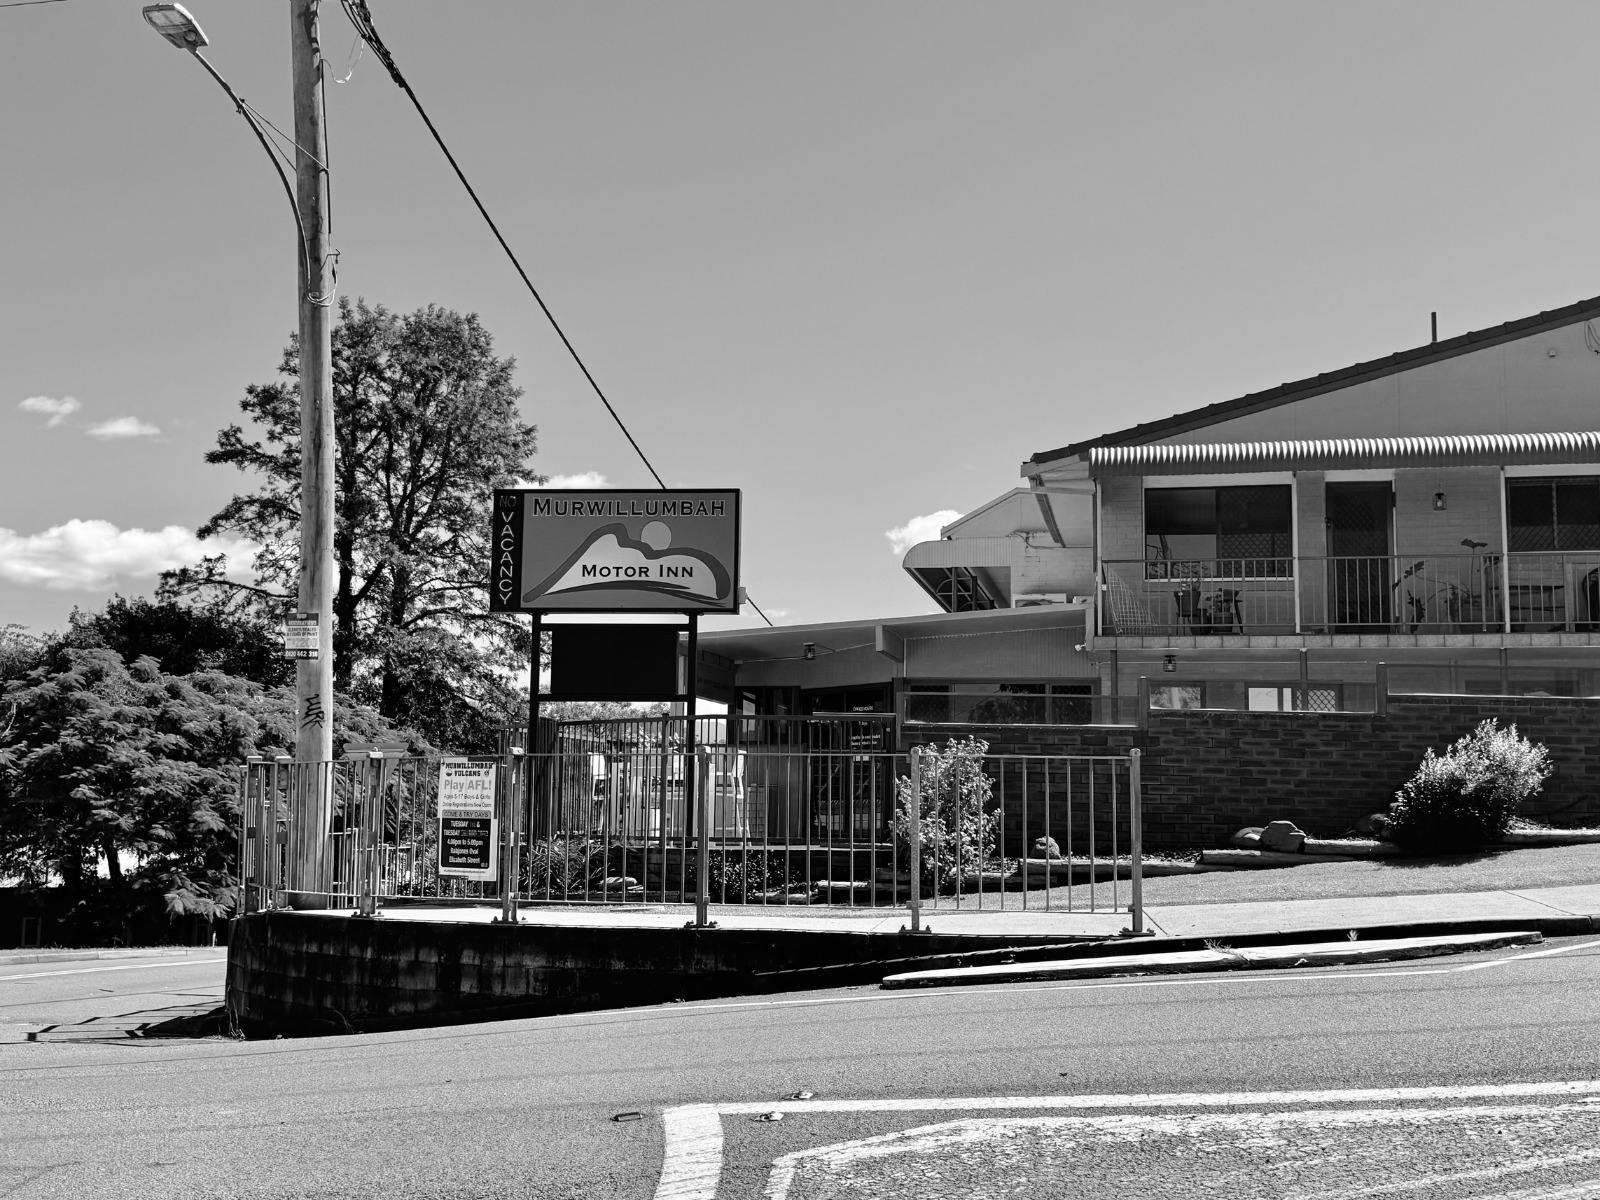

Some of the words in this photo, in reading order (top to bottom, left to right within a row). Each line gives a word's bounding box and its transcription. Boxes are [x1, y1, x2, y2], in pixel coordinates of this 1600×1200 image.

[532, 497, 726, 517] MURWILLUMBAH
[498, 511, 515, 606] VACANCY
[581, 564, 651, 578] MOTOR
[659, 564, 694, 578] INN
[444, 779, 465, 793] Play
[467, 780, 492, 790] AFL!
[450, 820, 469, 828] TUESDAY
